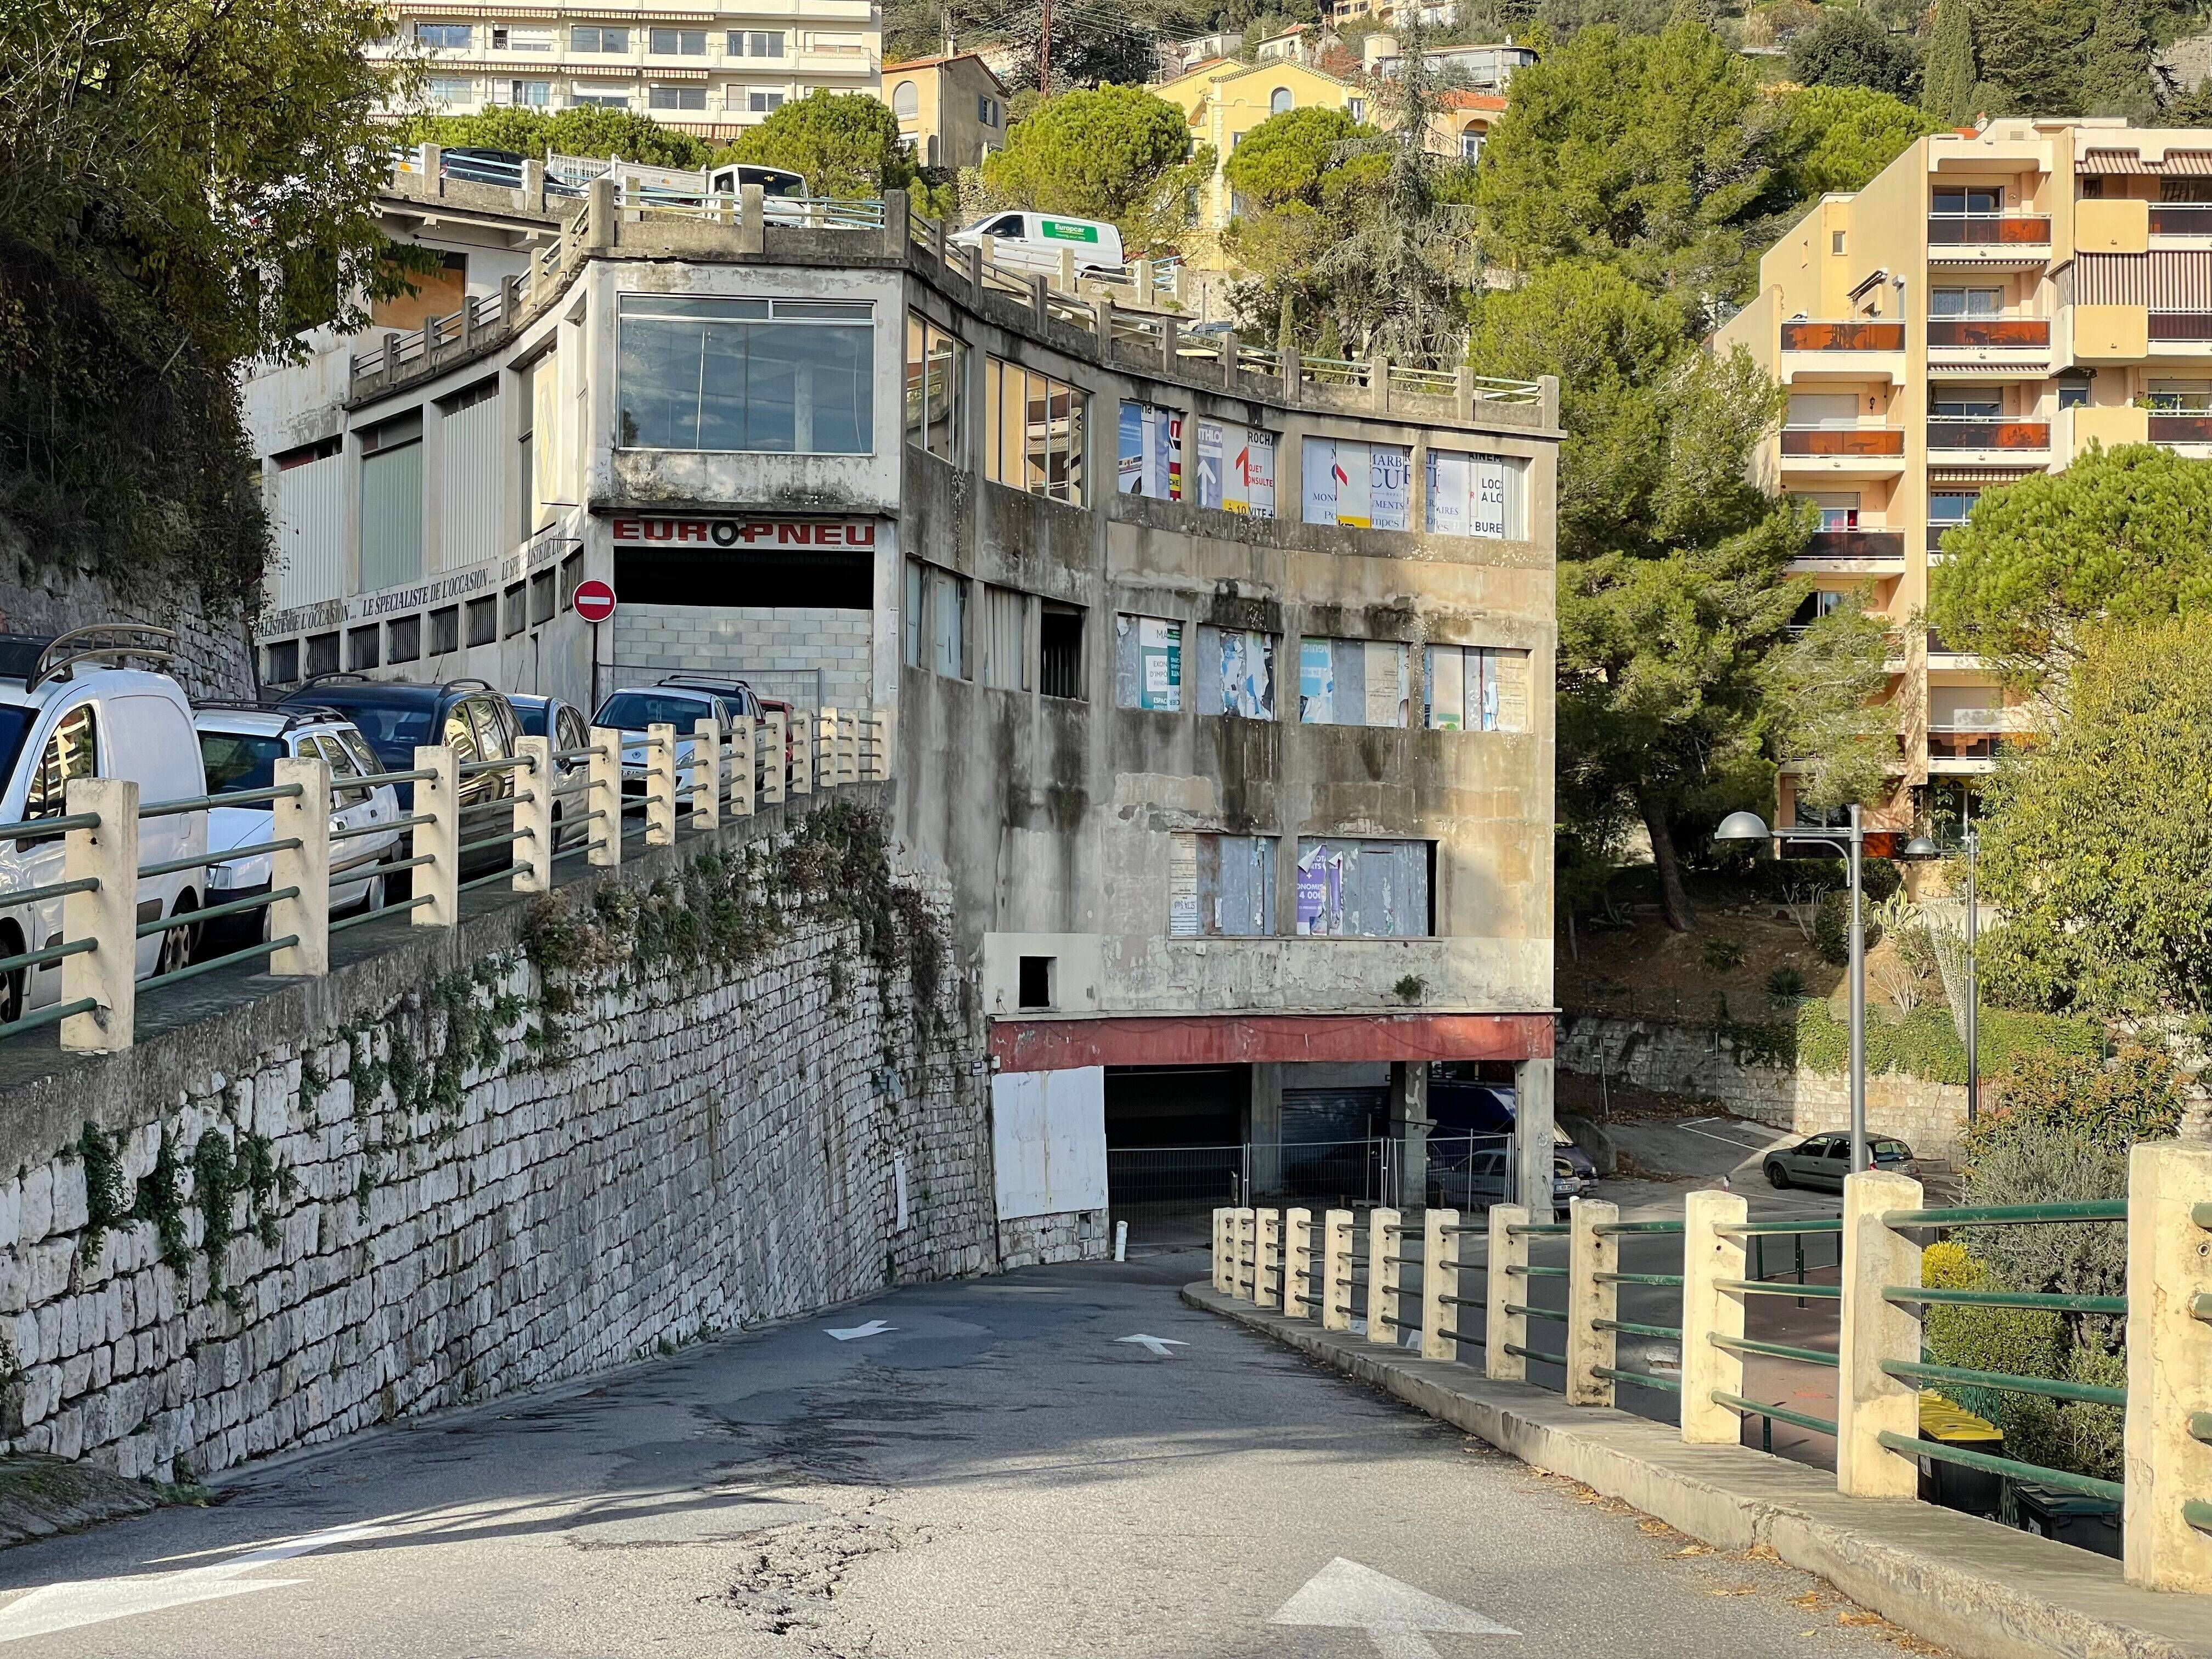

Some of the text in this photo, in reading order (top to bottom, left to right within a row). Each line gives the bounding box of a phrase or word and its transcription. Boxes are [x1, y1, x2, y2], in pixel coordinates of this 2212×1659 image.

[1055, 223, 1085, 233] Europcar
[1482, 478, 1502, 489] LOC
[501, 560, 509, 581] LE
[363, 599, 374, 617] LE
[375, 586, 428, 614] SPECIALISTE
[430, 581, 441, 602] DE
[442, 568, 488, 599] L'OCCASION
[301, 605, 349, 630] L'OCCASION
